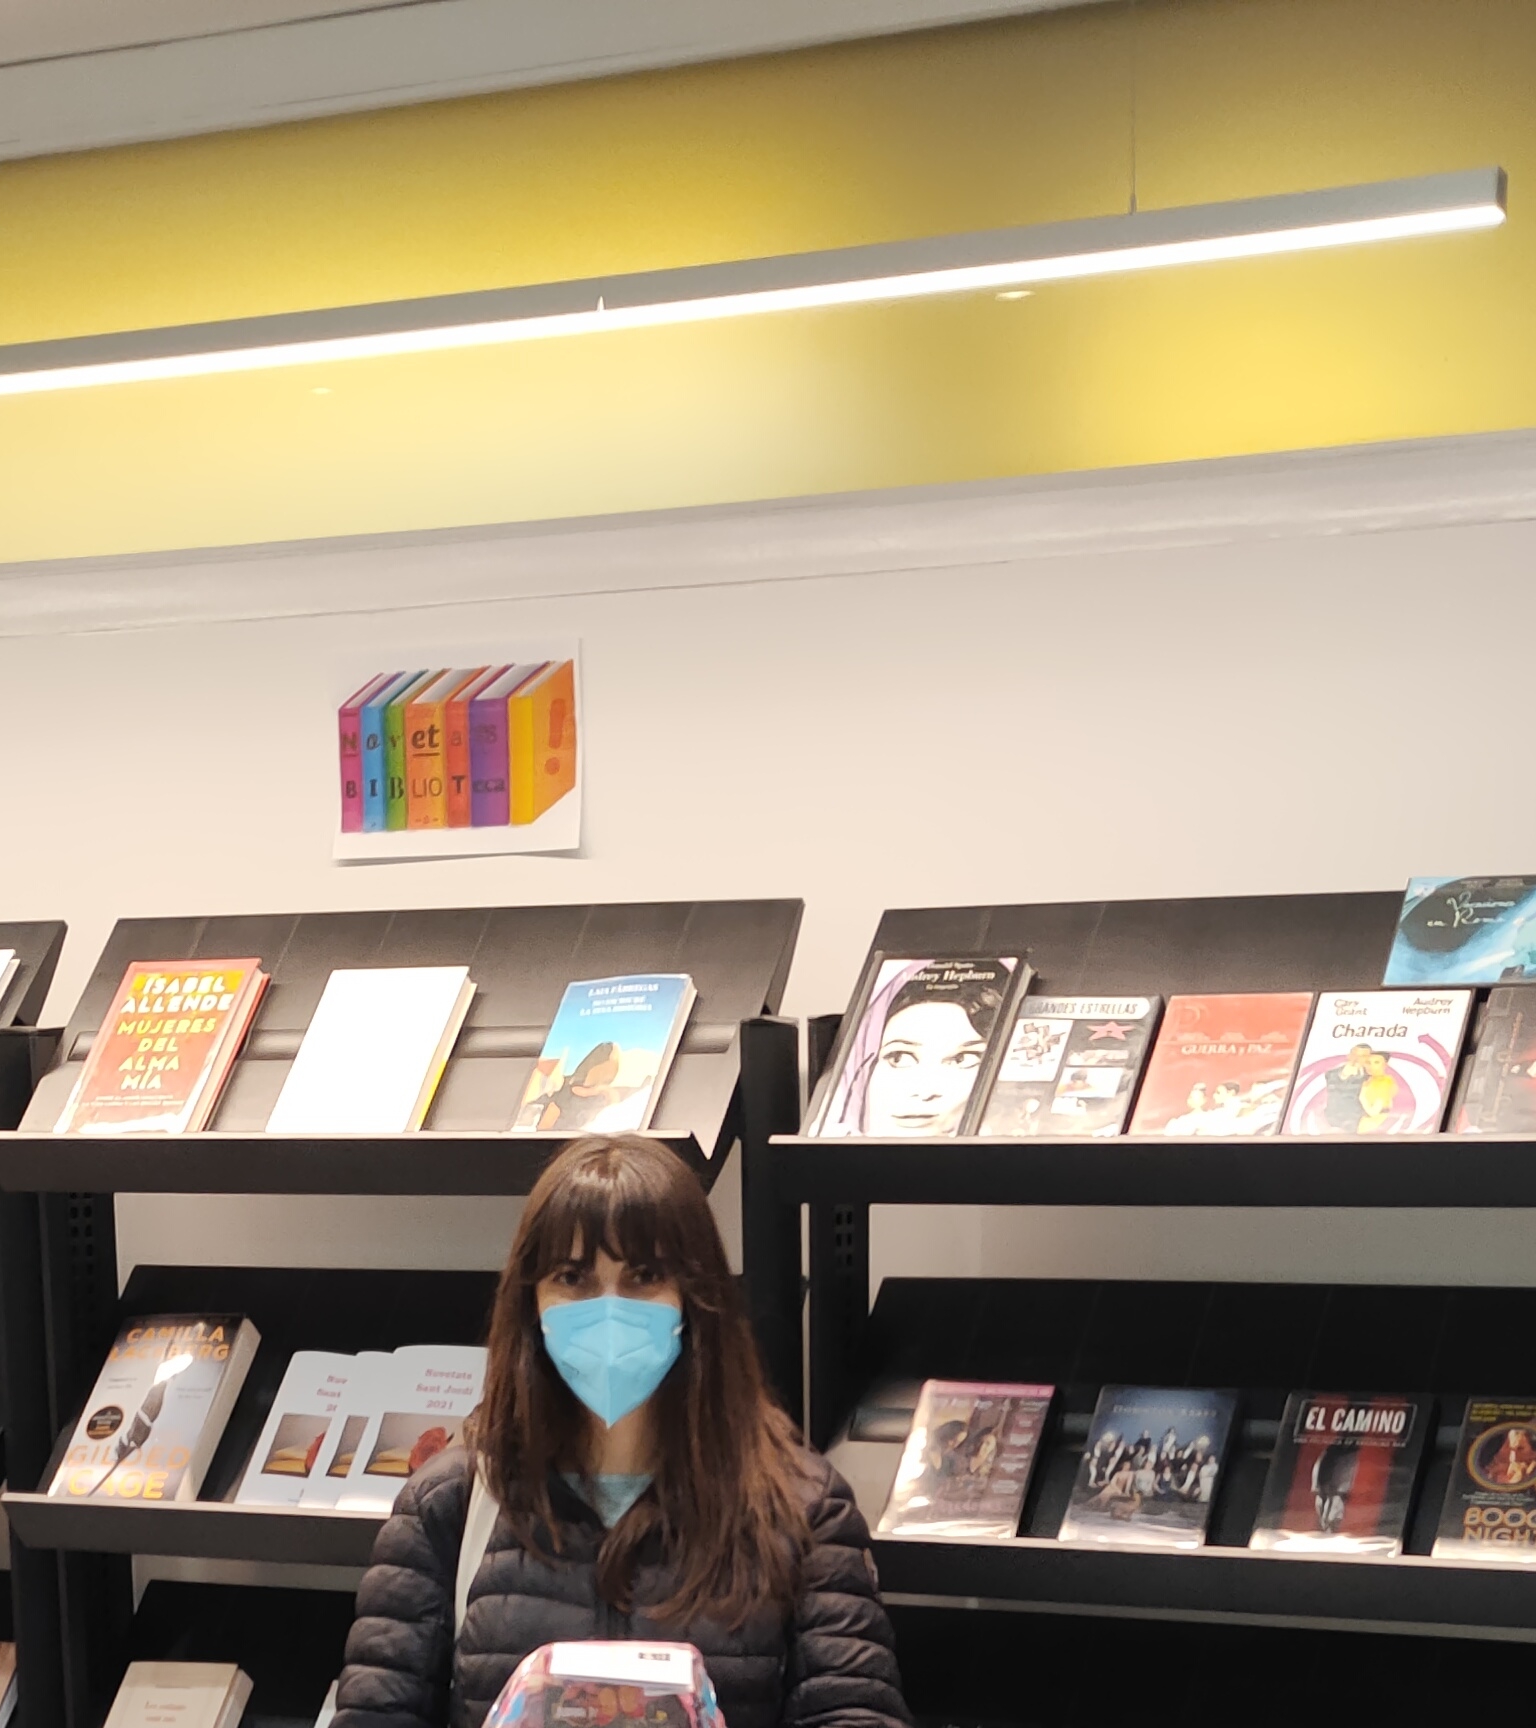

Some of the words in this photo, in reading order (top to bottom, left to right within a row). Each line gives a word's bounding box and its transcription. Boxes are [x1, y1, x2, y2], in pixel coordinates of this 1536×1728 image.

[142, 975, 226, 994] ISABEL
[943, 970, 995, 982] Hepburn
[120, 993, 234, 1014] ALLENDE
[1080, 1003, 1138, 1015] ESTRELLAS
[117, 1018, 217, 1035] MUJERES
[1332, 1023, 1408, 1039] Charada
[137, 1037, 179, 1052] DEL
[119, 1056, 180, 1071] ALMA
[126, 1325, 225, 1345] CAMILLA
[425, 1399, 453, 1410] 2021
[1305, 1407, 1326, 1431] EL
[1330, 1408, 1407, 1433] CAMINO
[67, 1444, 191, 1470] GILDED
[68, 1468, 169, 1499] CAGE
